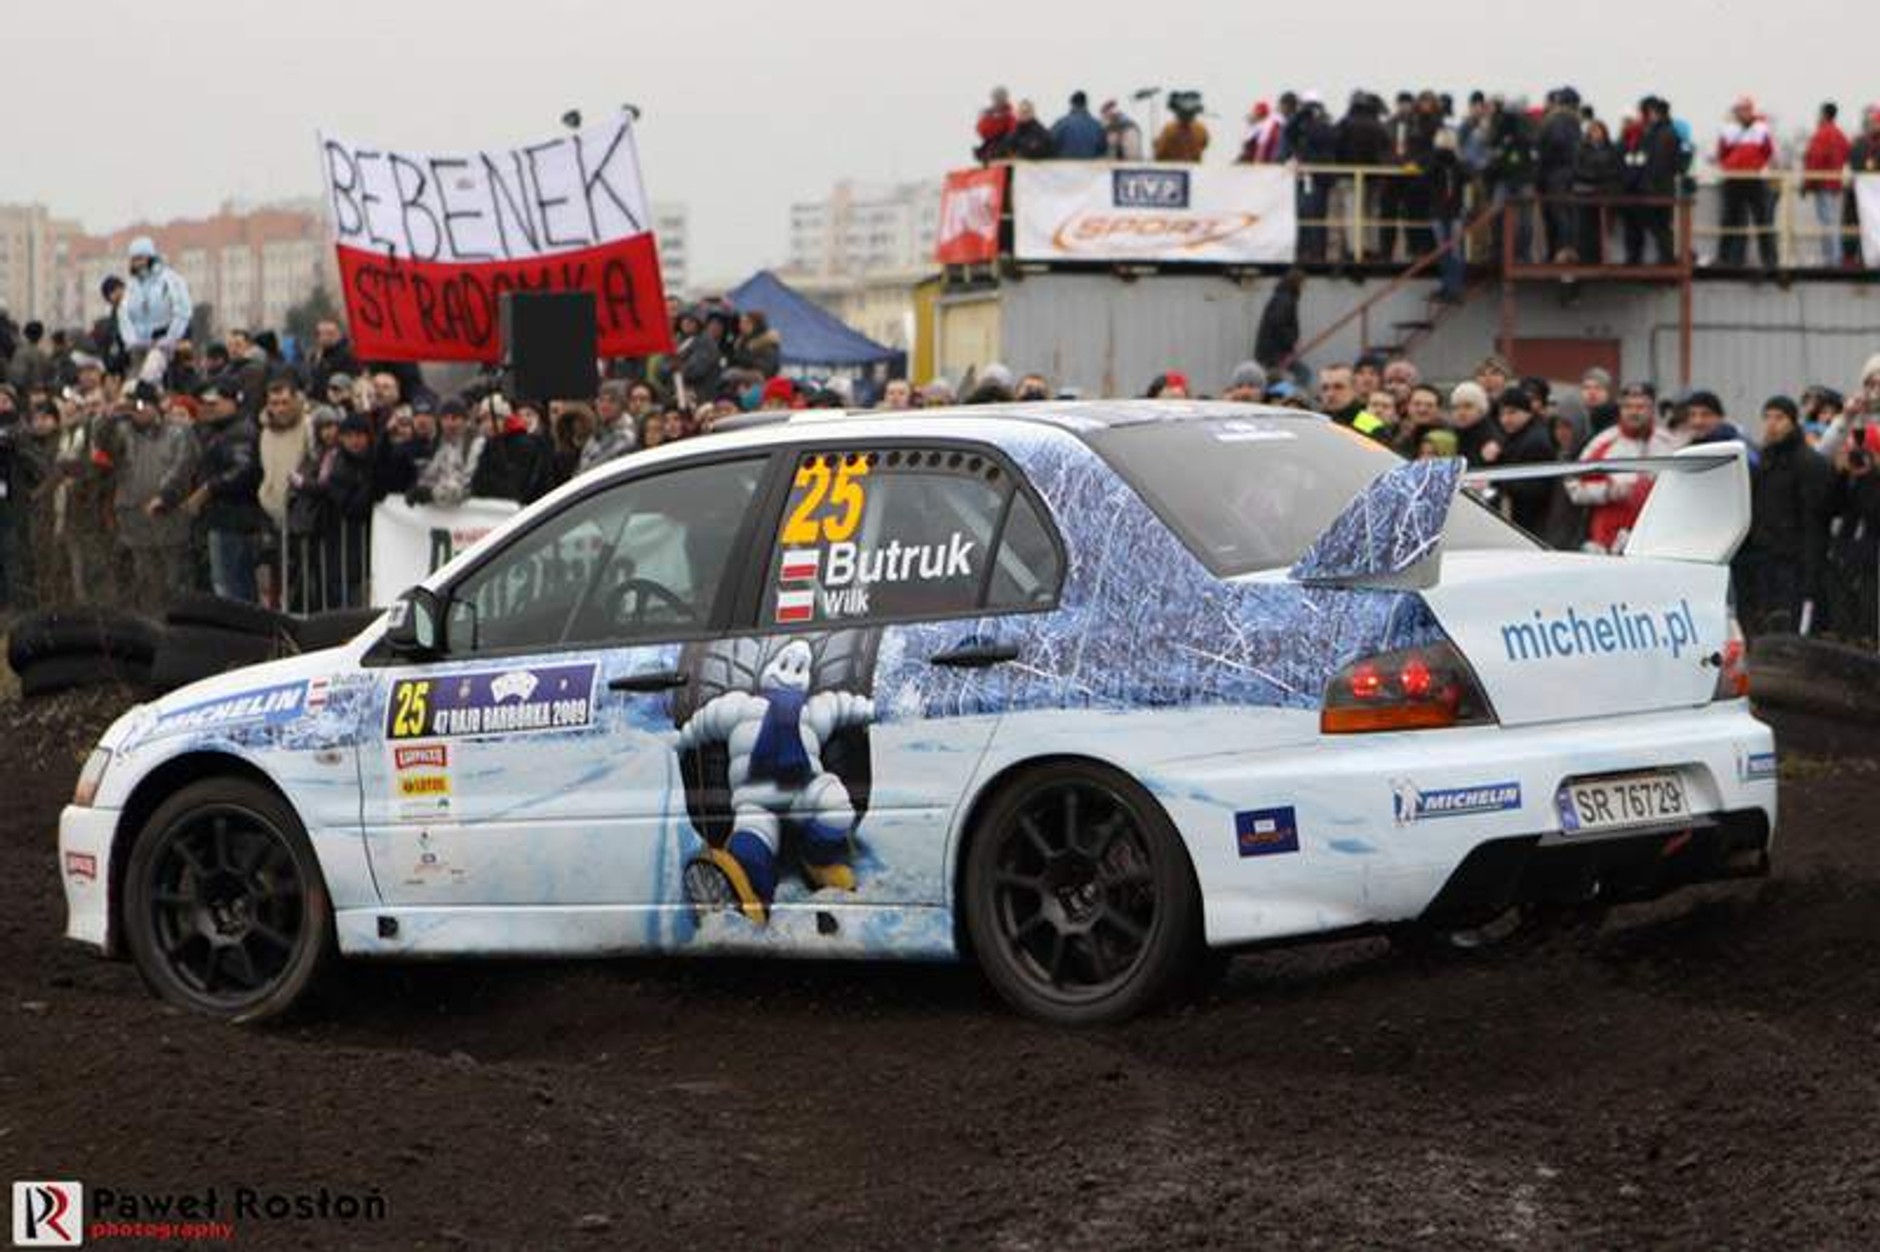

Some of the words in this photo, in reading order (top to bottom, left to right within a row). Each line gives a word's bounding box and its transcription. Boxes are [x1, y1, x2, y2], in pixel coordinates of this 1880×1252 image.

[325, 122, 641, 268] BĘBENEK
[1118, 175, 1183, 202] TVP
[1073, 214, 1221, 240] SPORT
[780, 454, 870, 544] 25
[825, 532, 975, 586] Butruk
[823, 588, 869, 614] Wilk
[1501, 598, 1698, 660] michelin.pl
[393, 682, 429, 736] 25
[433, 709, 448, 734] 47
[552, 698, 587, 725] 2009
[1425, 787, 1518, 810] MICHELIN
[1576, 789, 1614, 823] SR
[1614, 777, 1682, 819] 76729
